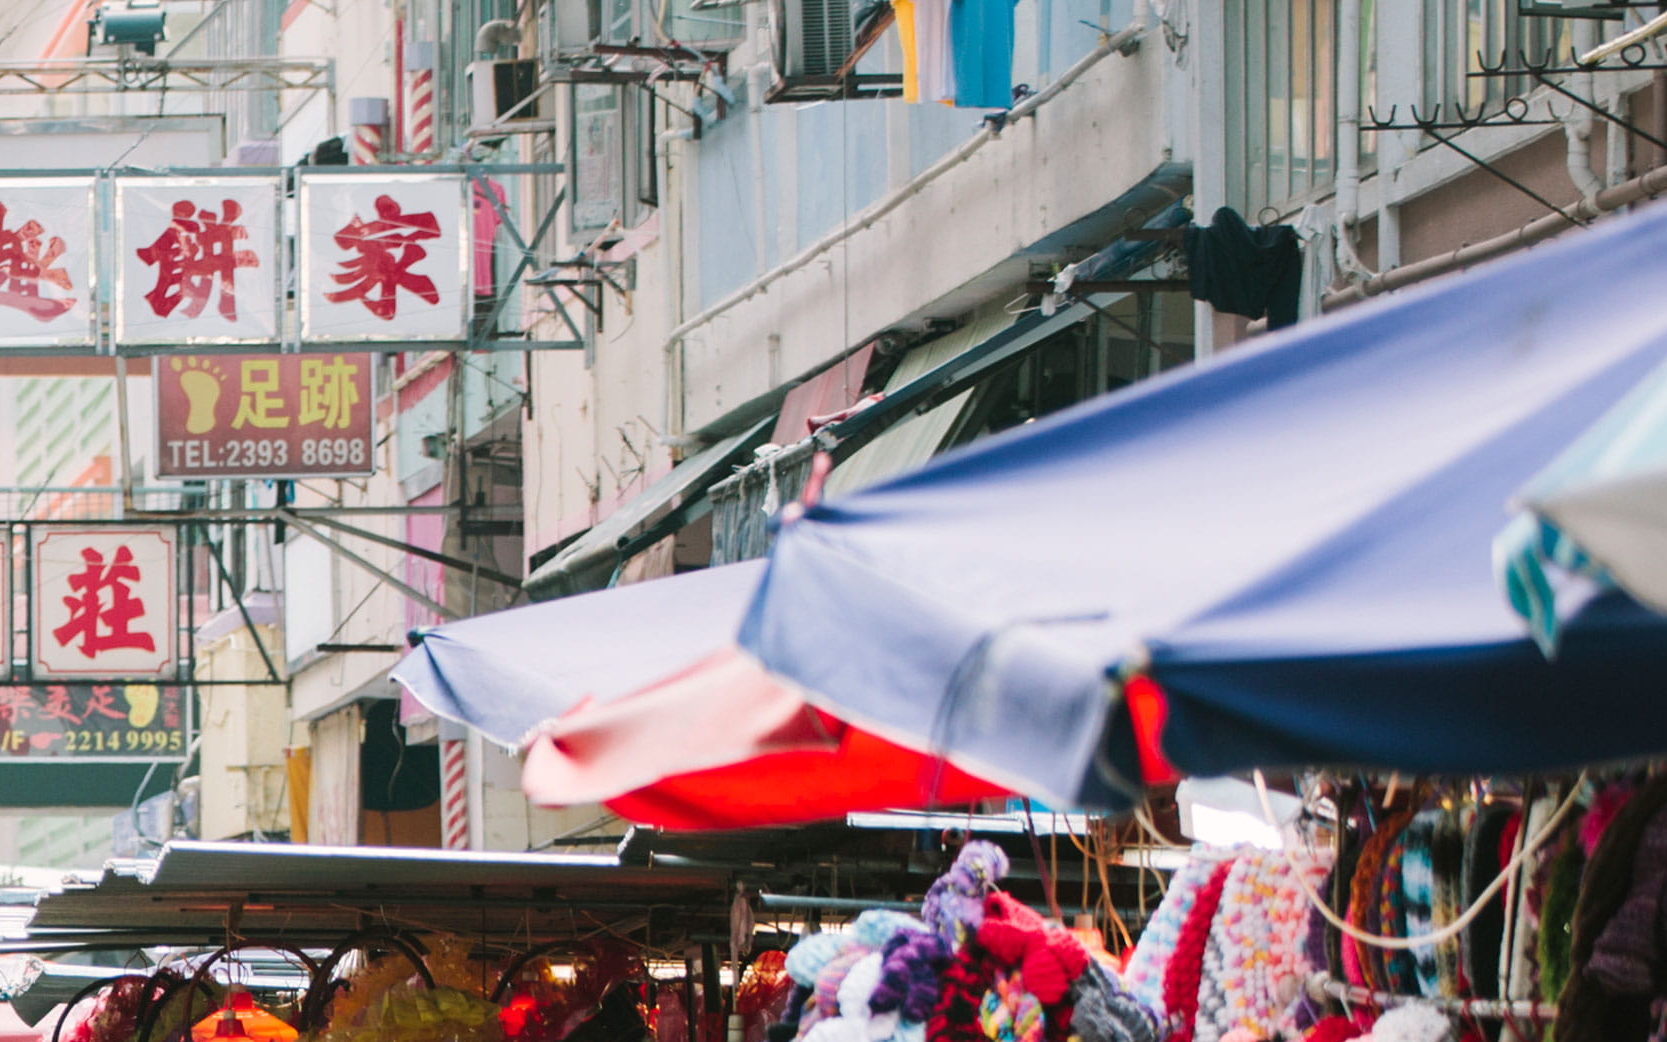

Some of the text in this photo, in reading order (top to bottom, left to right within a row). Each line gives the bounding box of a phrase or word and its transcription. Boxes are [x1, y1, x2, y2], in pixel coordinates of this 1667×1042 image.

[230, 355, 359, 429] 足跡
[167, 437, 365, 468] TEL:2393 8698
[64, 729, 120, 751] 2214
[126, 729, 182, 751] 9995
